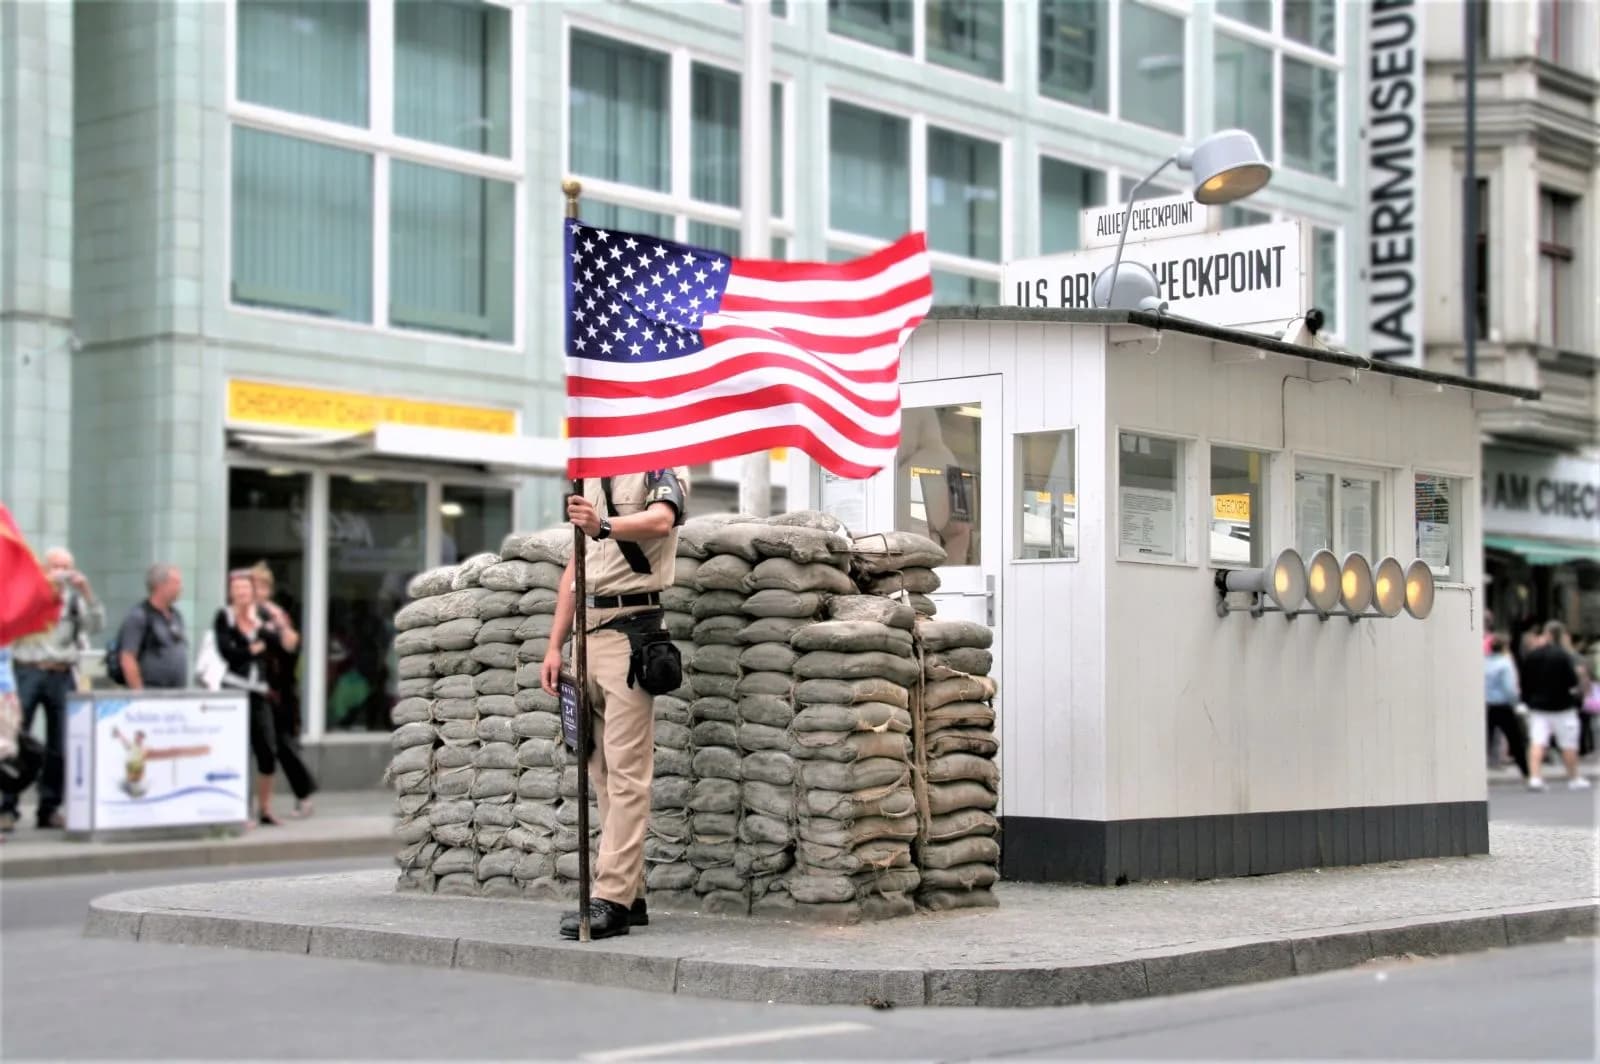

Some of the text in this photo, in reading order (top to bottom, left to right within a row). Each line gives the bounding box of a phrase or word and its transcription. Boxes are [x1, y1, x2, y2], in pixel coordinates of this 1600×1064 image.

[1132, 201, 1195, 232] CHECKPOINT
[1151, 245, 1286, 302] HECKPOINT
[1493, 471, 1531, 512] AM
[1536, 477, 1600, 521] CHEC
